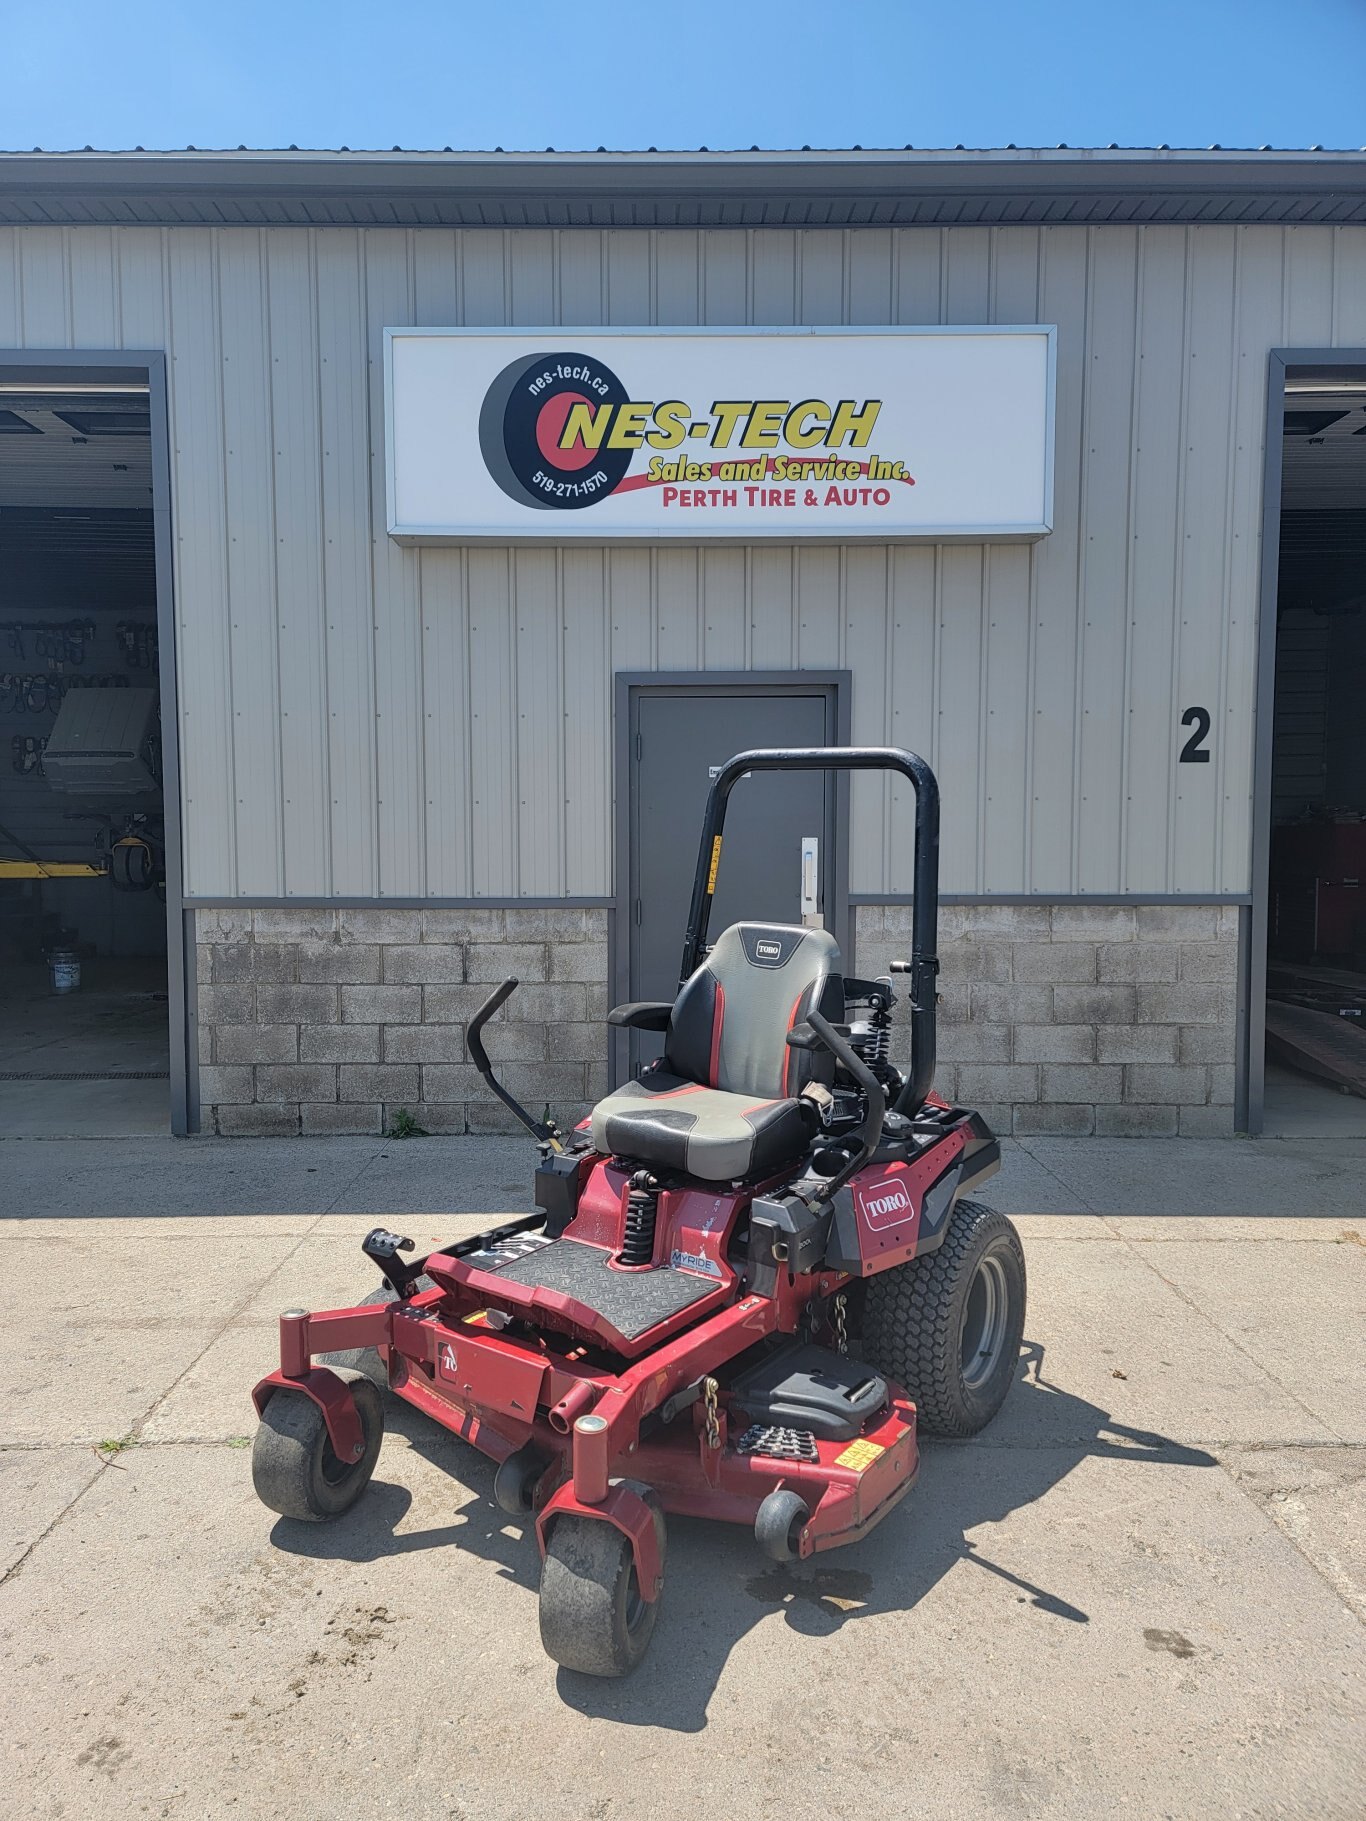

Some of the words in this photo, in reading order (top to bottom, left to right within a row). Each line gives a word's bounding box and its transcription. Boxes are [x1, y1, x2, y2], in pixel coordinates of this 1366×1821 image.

[528, 364, 610, 396] nes-tech.ca
[556, 399, 883, 450] NES-TECH
[647, 454, 712, 481] Sales
[719, 453, 769, 481] and
[772, 453, 861, 481] Service
[867, 455, 910, 480] Inc.
[532, 470, 608, 497] 519-271-1570
[663, 487, 737, 507] PERTH
[744, 486, 796, 507] TIRE
[804, 489, 819, 507] &
[824, 486, 891, 506] AUTO
[1180, 706, 1211, 763] 2
[759, 945, 778, 954] TORO
[866, 1192, 906, 1217] TORO
